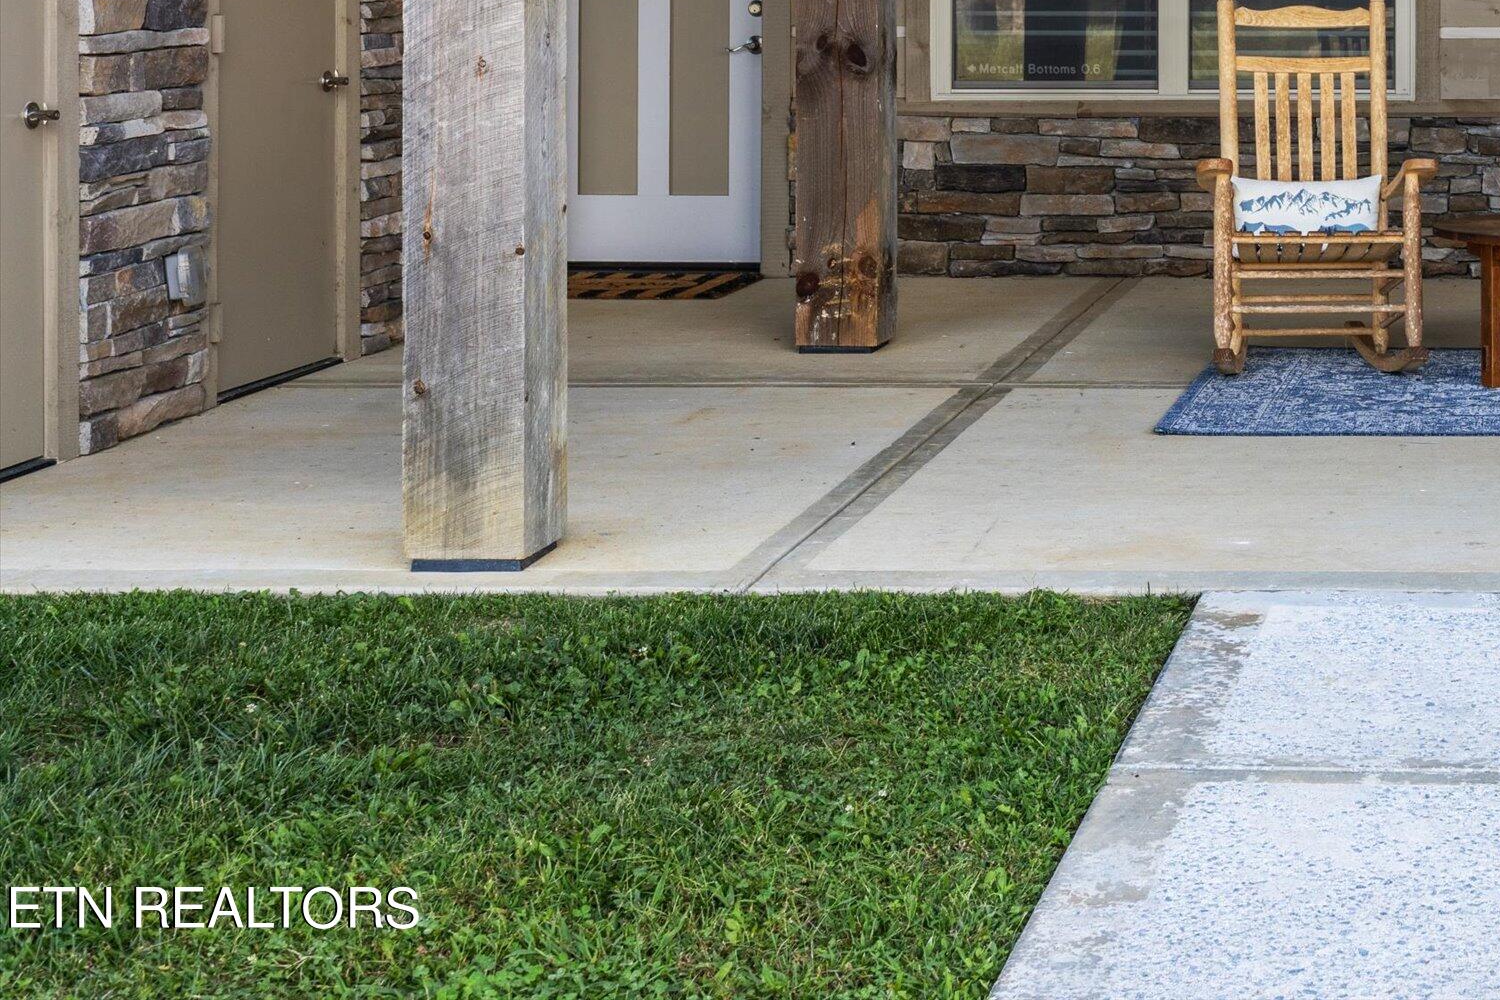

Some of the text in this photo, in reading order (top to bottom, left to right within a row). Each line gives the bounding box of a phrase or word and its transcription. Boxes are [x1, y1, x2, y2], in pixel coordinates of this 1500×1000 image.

[979, 63, 1101, 74] Metcalf Bottoms 0.6
